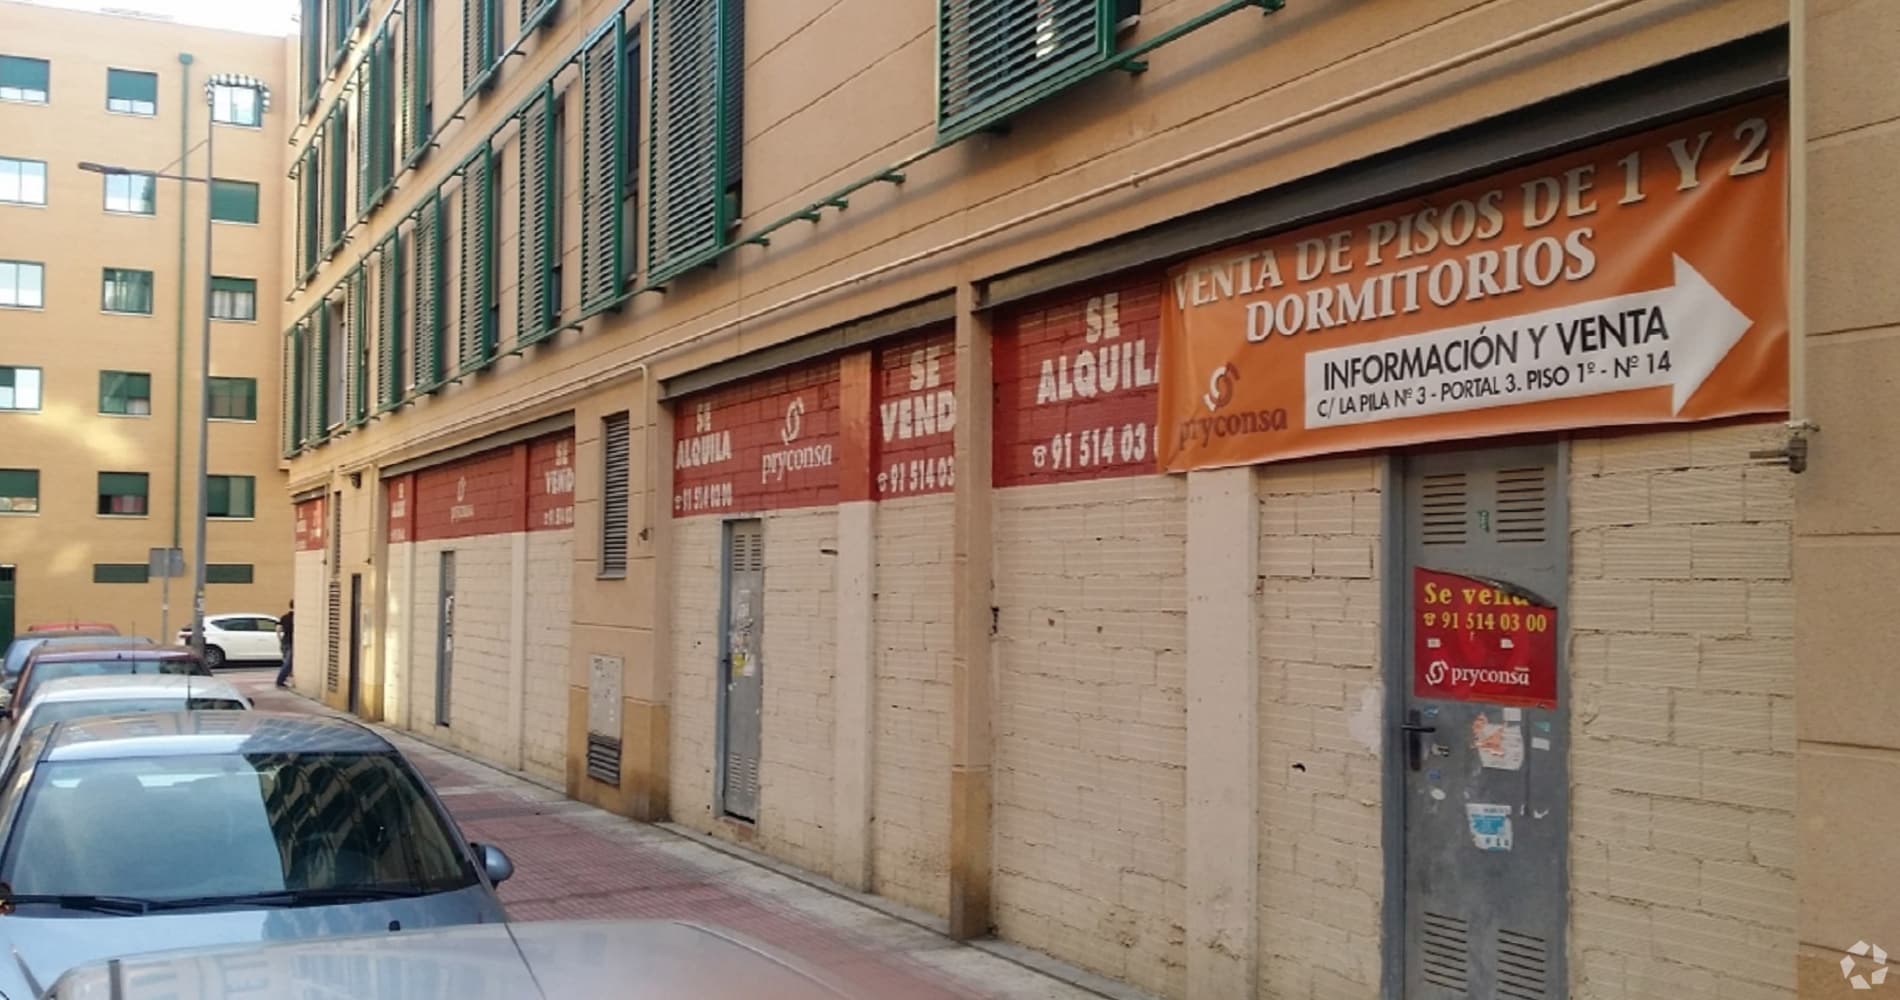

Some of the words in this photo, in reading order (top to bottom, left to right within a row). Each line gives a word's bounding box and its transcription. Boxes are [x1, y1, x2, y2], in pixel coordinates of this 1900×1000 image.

[1175, 249, 1284, 310] VENTA
[1295, 230, 1353, 281] DE
[1366, 191, 1502, 267] PISOS
[1520, 165, 1598, 229] DE
[1618, 152, 1646, 205] 1
[1667, 131, 1713, 192] Y
[1728, 119, 1770, 177] 2
[1246, 227, 1595, 342] DORMITORIOS
[1086, 292, 1119, 343] SE
[910, 345, 940, 390] SE
[1037, 338, 1159, 404] ALQUIL
[1324, 326, 1518, 391] INFORMACIÓN
[1528, 325, 1548, 359] Y
[1556, 306, 1669, 355] VENTA
[1317, 398, 1335, 419] C/
[1340, 396, 1356, 414] LA
[1360, 392, 1390, 412] PILA
[1394, 387, 1412, 408] Nº
[1415, 386, 1426, 405] 3
[1441, 377, 1500, 401] PORTAL
[1506, 373, 1522, 393] 3.
[1527, 366, 1569, 390] PISO
[1577, 362, 1595, 383] 1º
[1614, 355, 1638, 378] Nº
[1647, 350, 1671, 374] 14
[676, 430, 731, 469] ALQUILA
[762, 444, 832, 484] pryconsa
[1052, 433, 1072, 469] 91
[1080, 426, 1114, 467] 514
[1121, 422, 1146, 463] 03
[891, 463, 905, 492] 91
[910, 458, 933, 490] 514
[1424, 582, 1452, 604] Se
[1442, 612, 1458, 629] 91
[1465, 612, 1495, 630] 514
[1500, 613, 1520, 631] 03
[1526, 614, 1546, 632] 00
[1451, 667, 1530, 687] pryconsa
